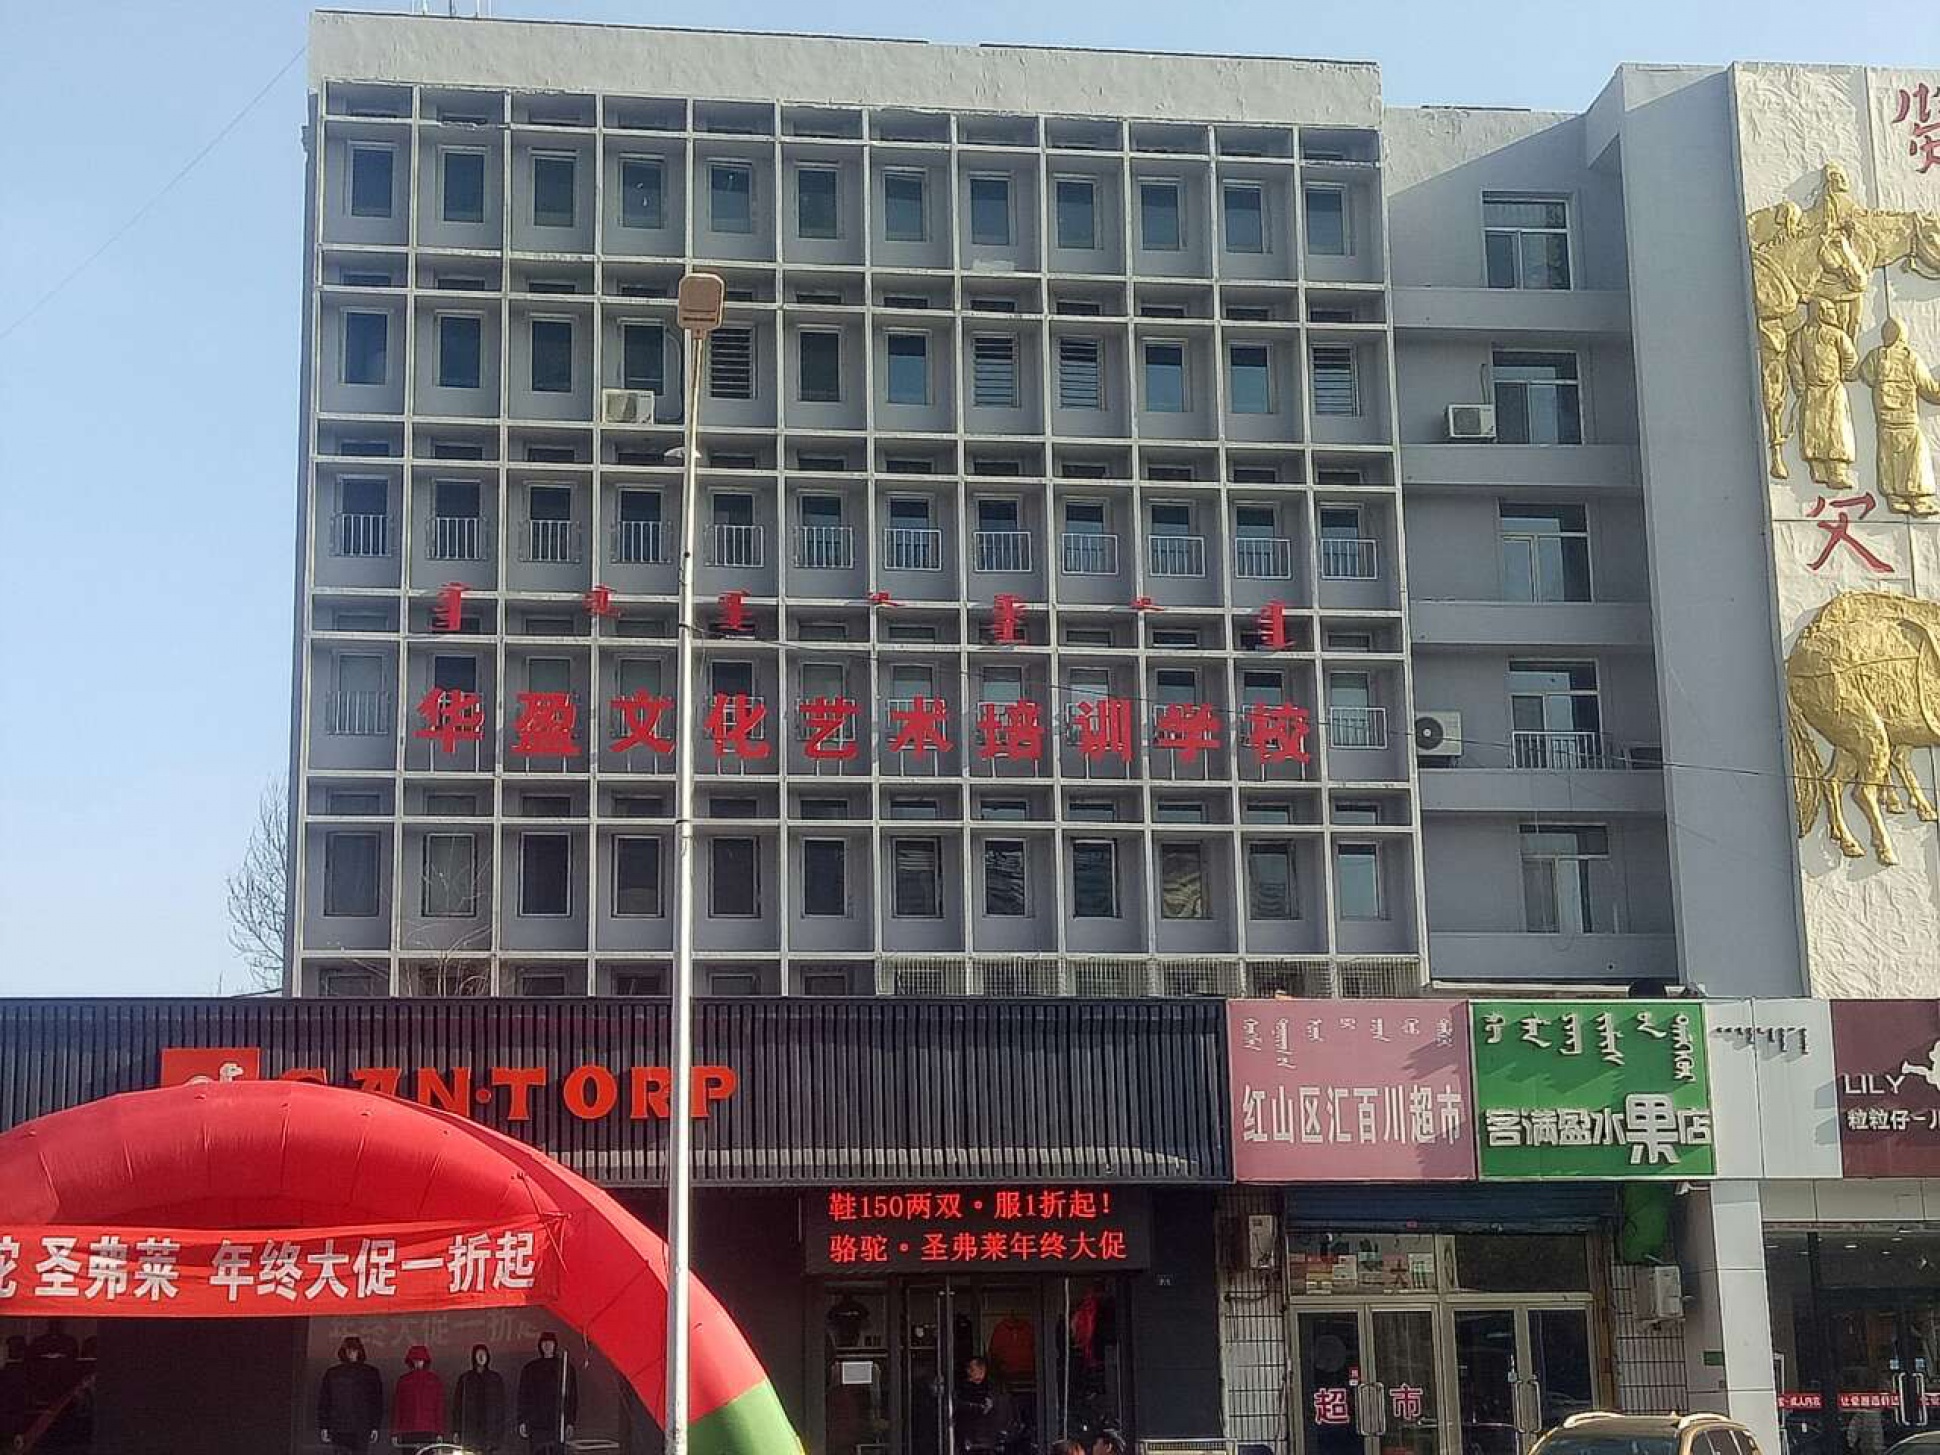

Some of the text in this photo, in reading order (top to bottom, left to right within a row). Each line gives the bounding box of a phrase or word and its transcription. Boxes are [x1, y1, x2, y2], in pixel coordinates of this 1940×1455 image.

[412, 687, 1310, 764] 华盈文化艺术培训学校
[1241, 1084, 1463, 1145] 红山区汇百川超市
[1844, 1074, 1906, 1094] LILY
[34, 1234, 181, 1302] 圣弗莱
[208, 1230, 536, 1302] 年终大促一折起
